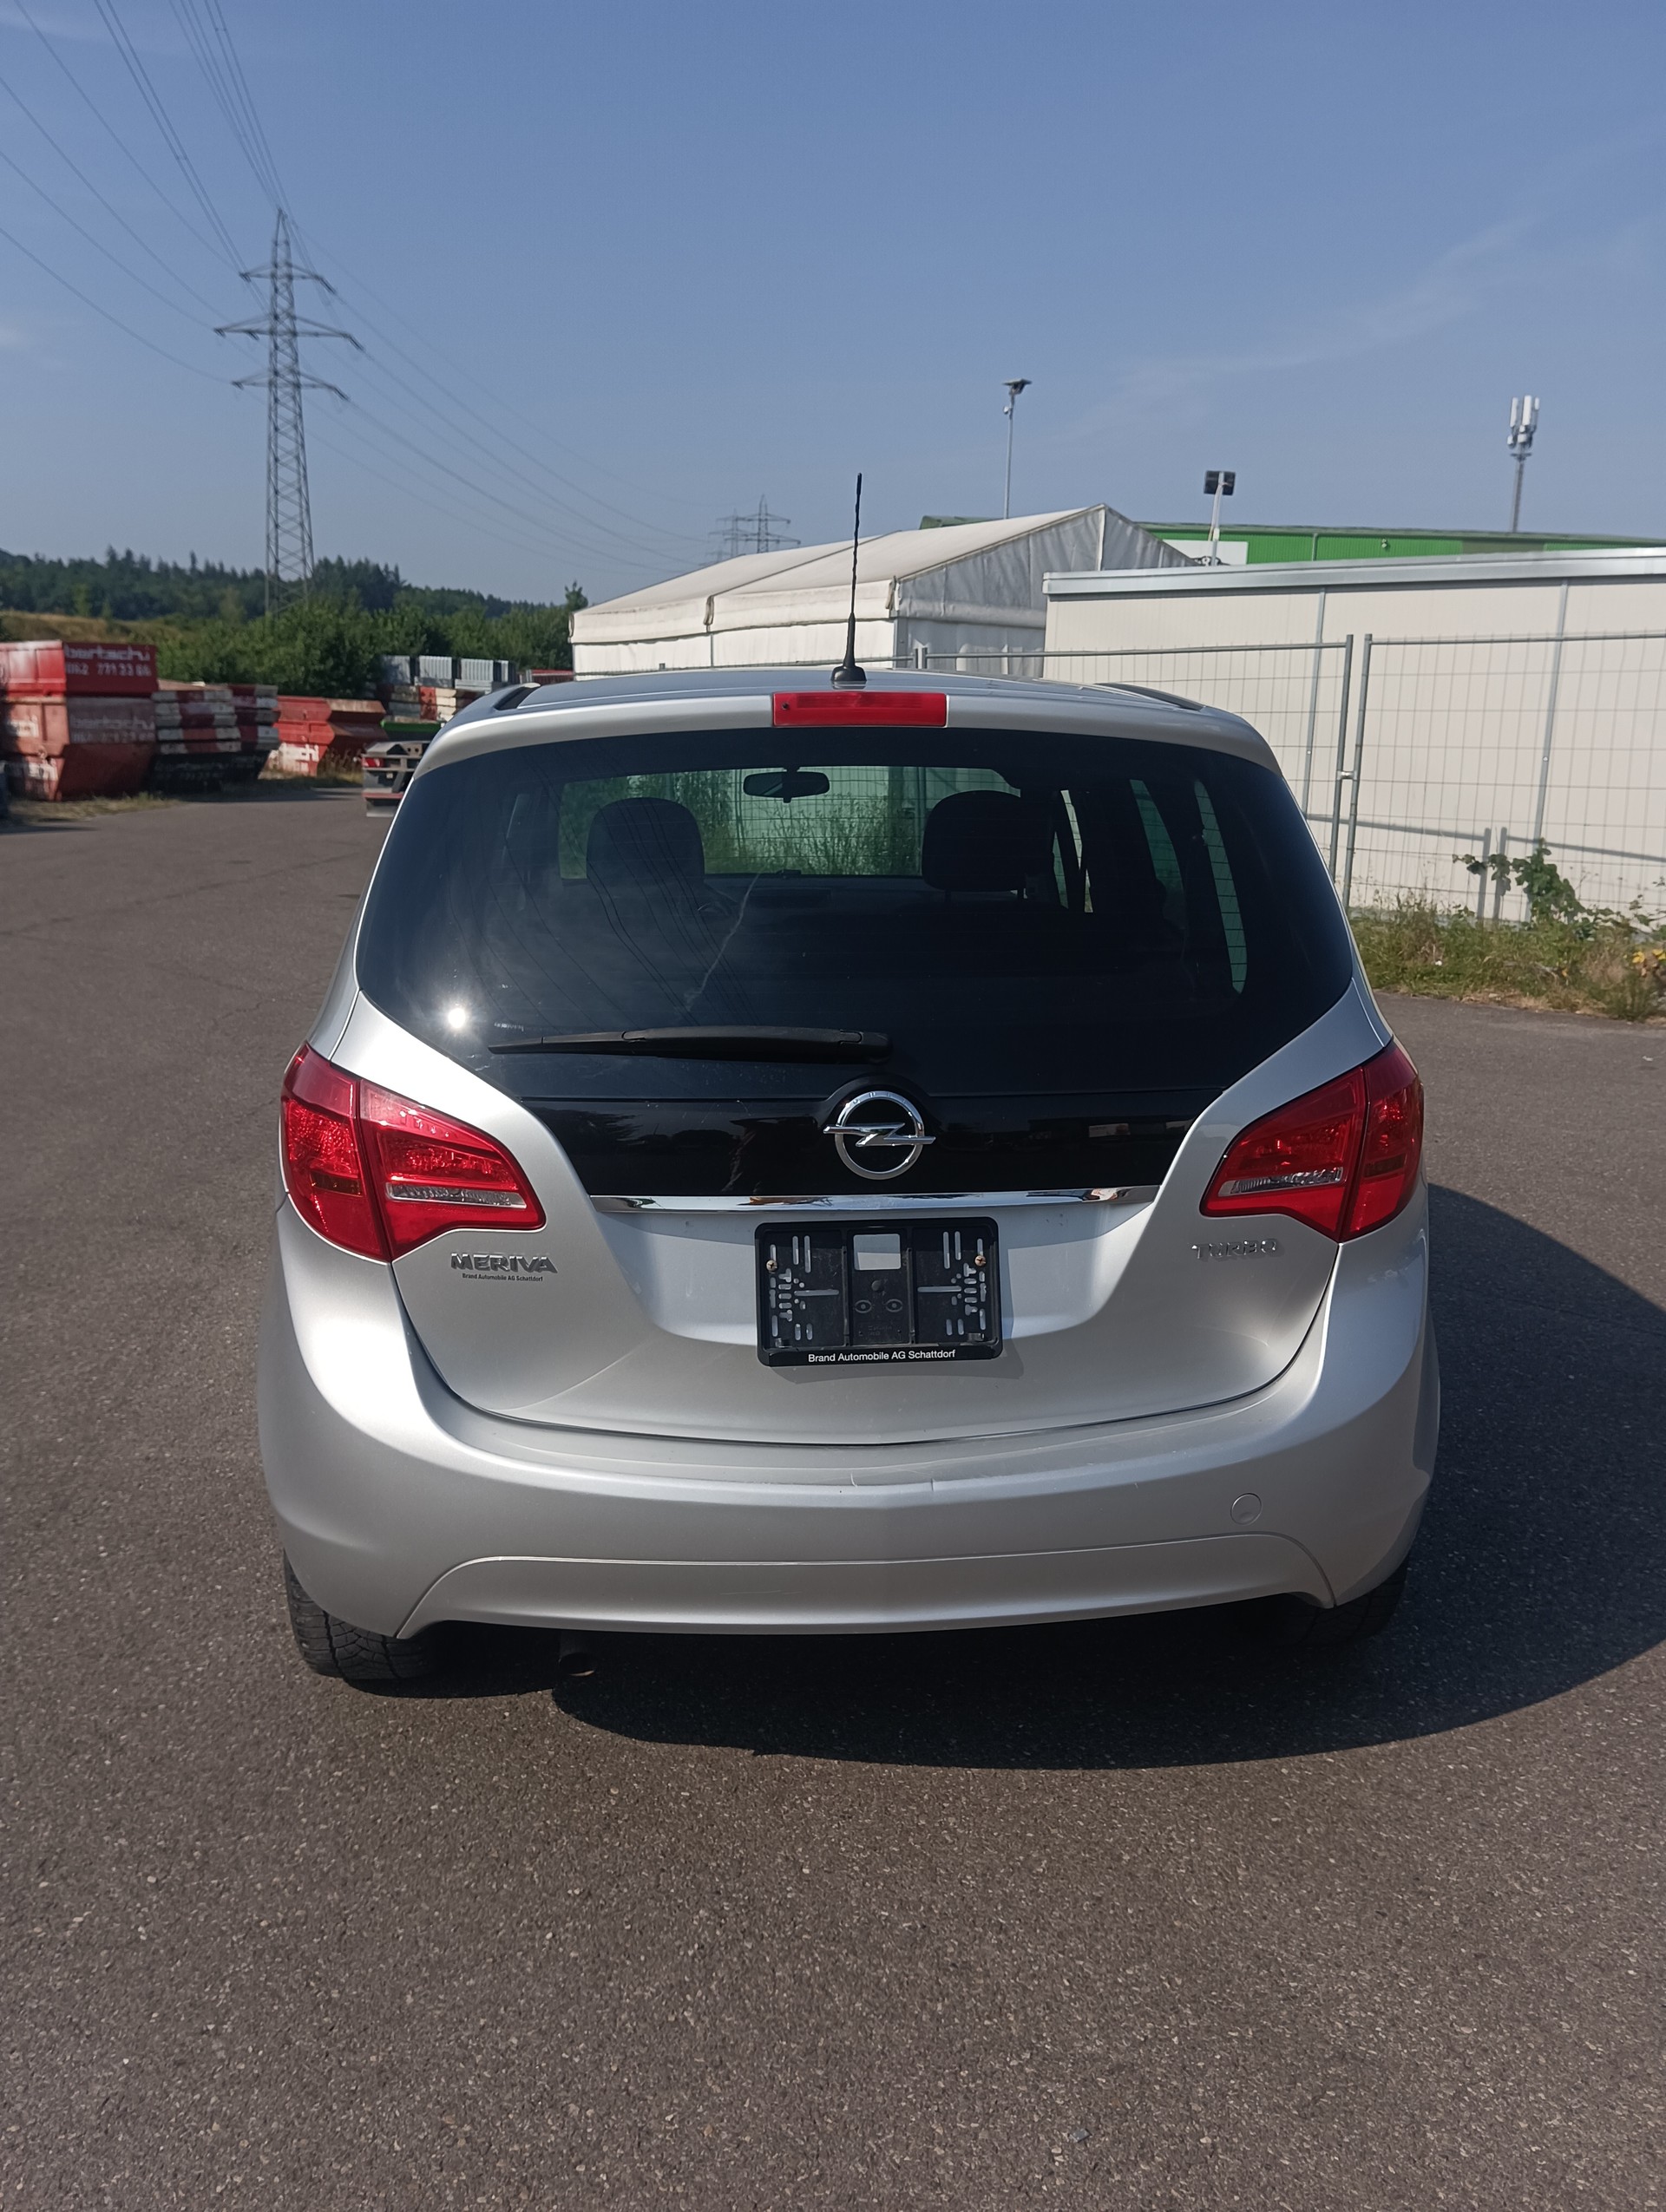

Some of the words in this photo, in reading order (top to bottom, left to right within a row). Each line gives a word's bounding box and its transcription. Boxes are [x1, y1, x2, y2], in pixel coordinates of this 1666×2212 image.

[1191, 1238, 1282, 1260] TURBO
[451, 1252, 558, 1273] MERIVA
[808, 1353, 836, 1363] Brand
[837, 1351, 889, 1362] Automobile
[891, 1351, 906, 1360] AG
[908, 1350, 956, 1359] Schattdorf
